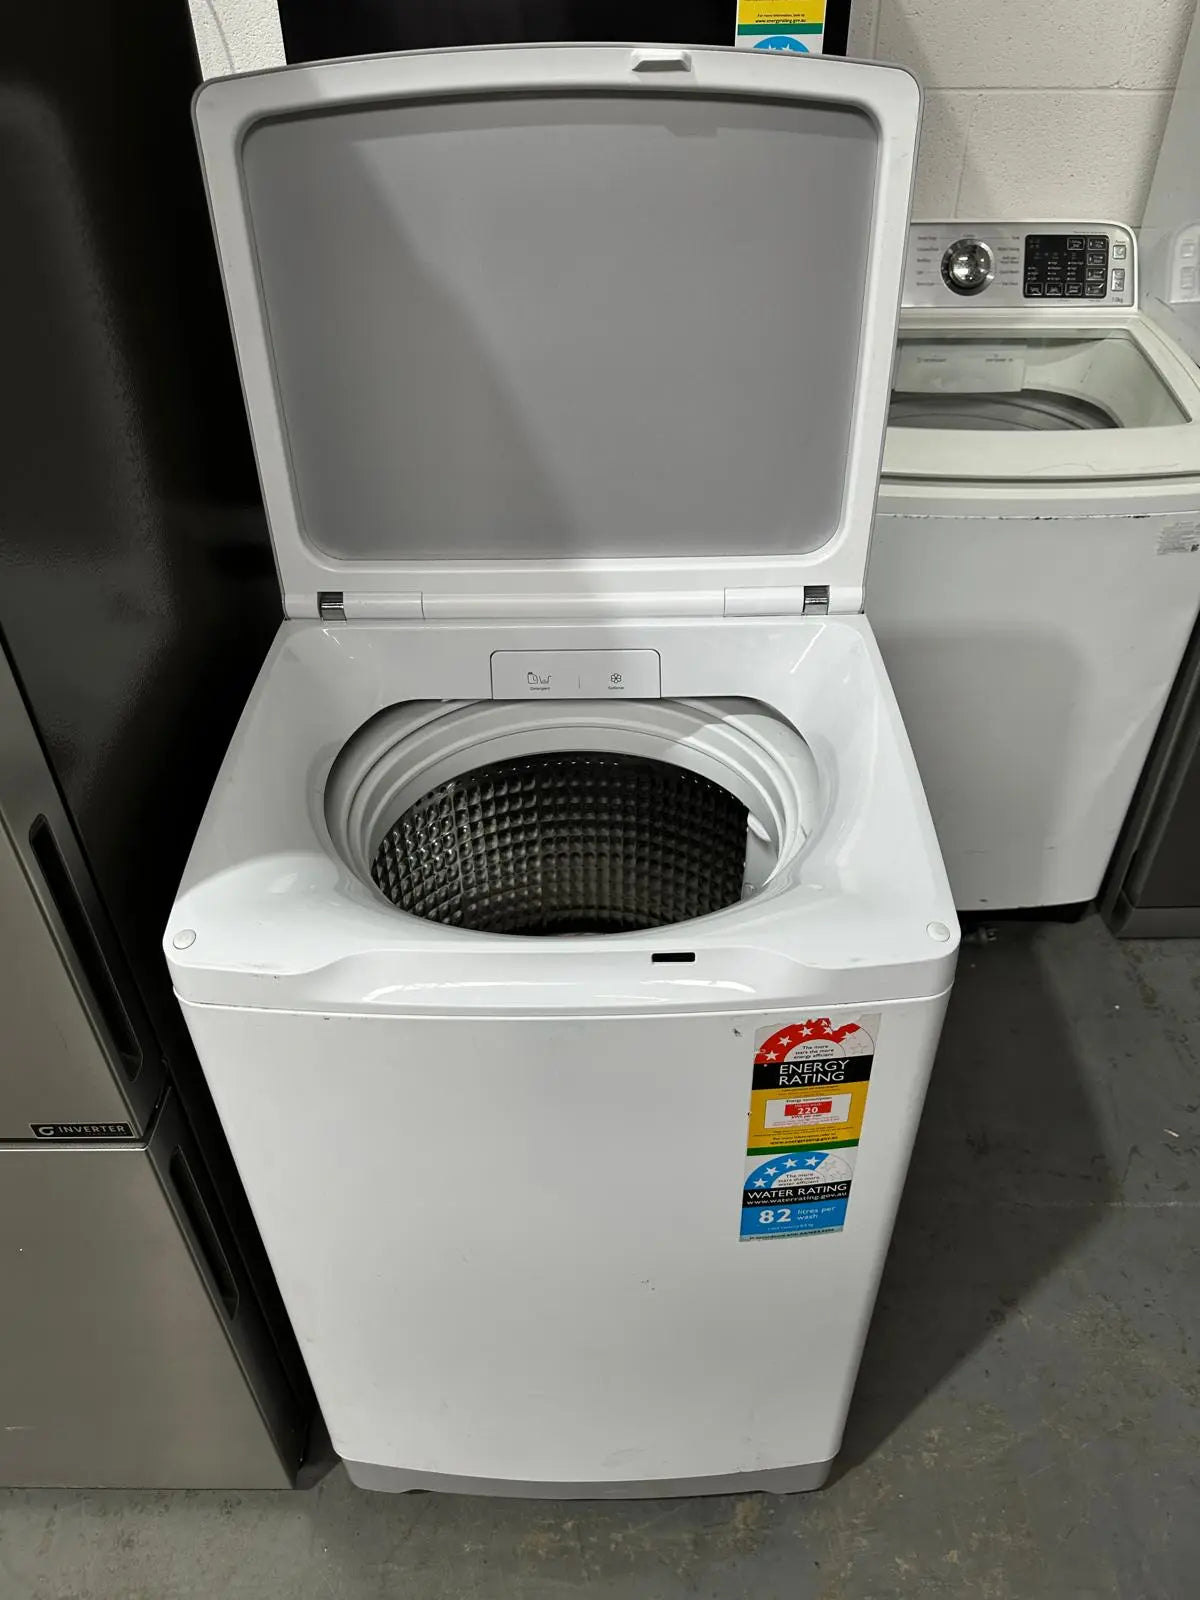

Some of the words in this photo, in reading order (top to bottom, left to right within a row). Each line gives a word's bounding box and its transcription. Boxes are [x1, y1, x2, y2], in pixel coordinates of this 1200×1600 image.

[780, 1060, 849, 1075] ENERGY
[779, 1072, 845, 1086] RATING
[797, 1106, 819, 1115] 220
[58, 1125, 126, 1133] INVERTER
[748, 1189, 793, 1199] WATER
[798, 1183, 847, 1196] RATING
[747, 1192, 847, 1205] www.waterrating.gov.au
[759, 1208, 791, 1224] 82
[821, 1206, 836, 1214] per
